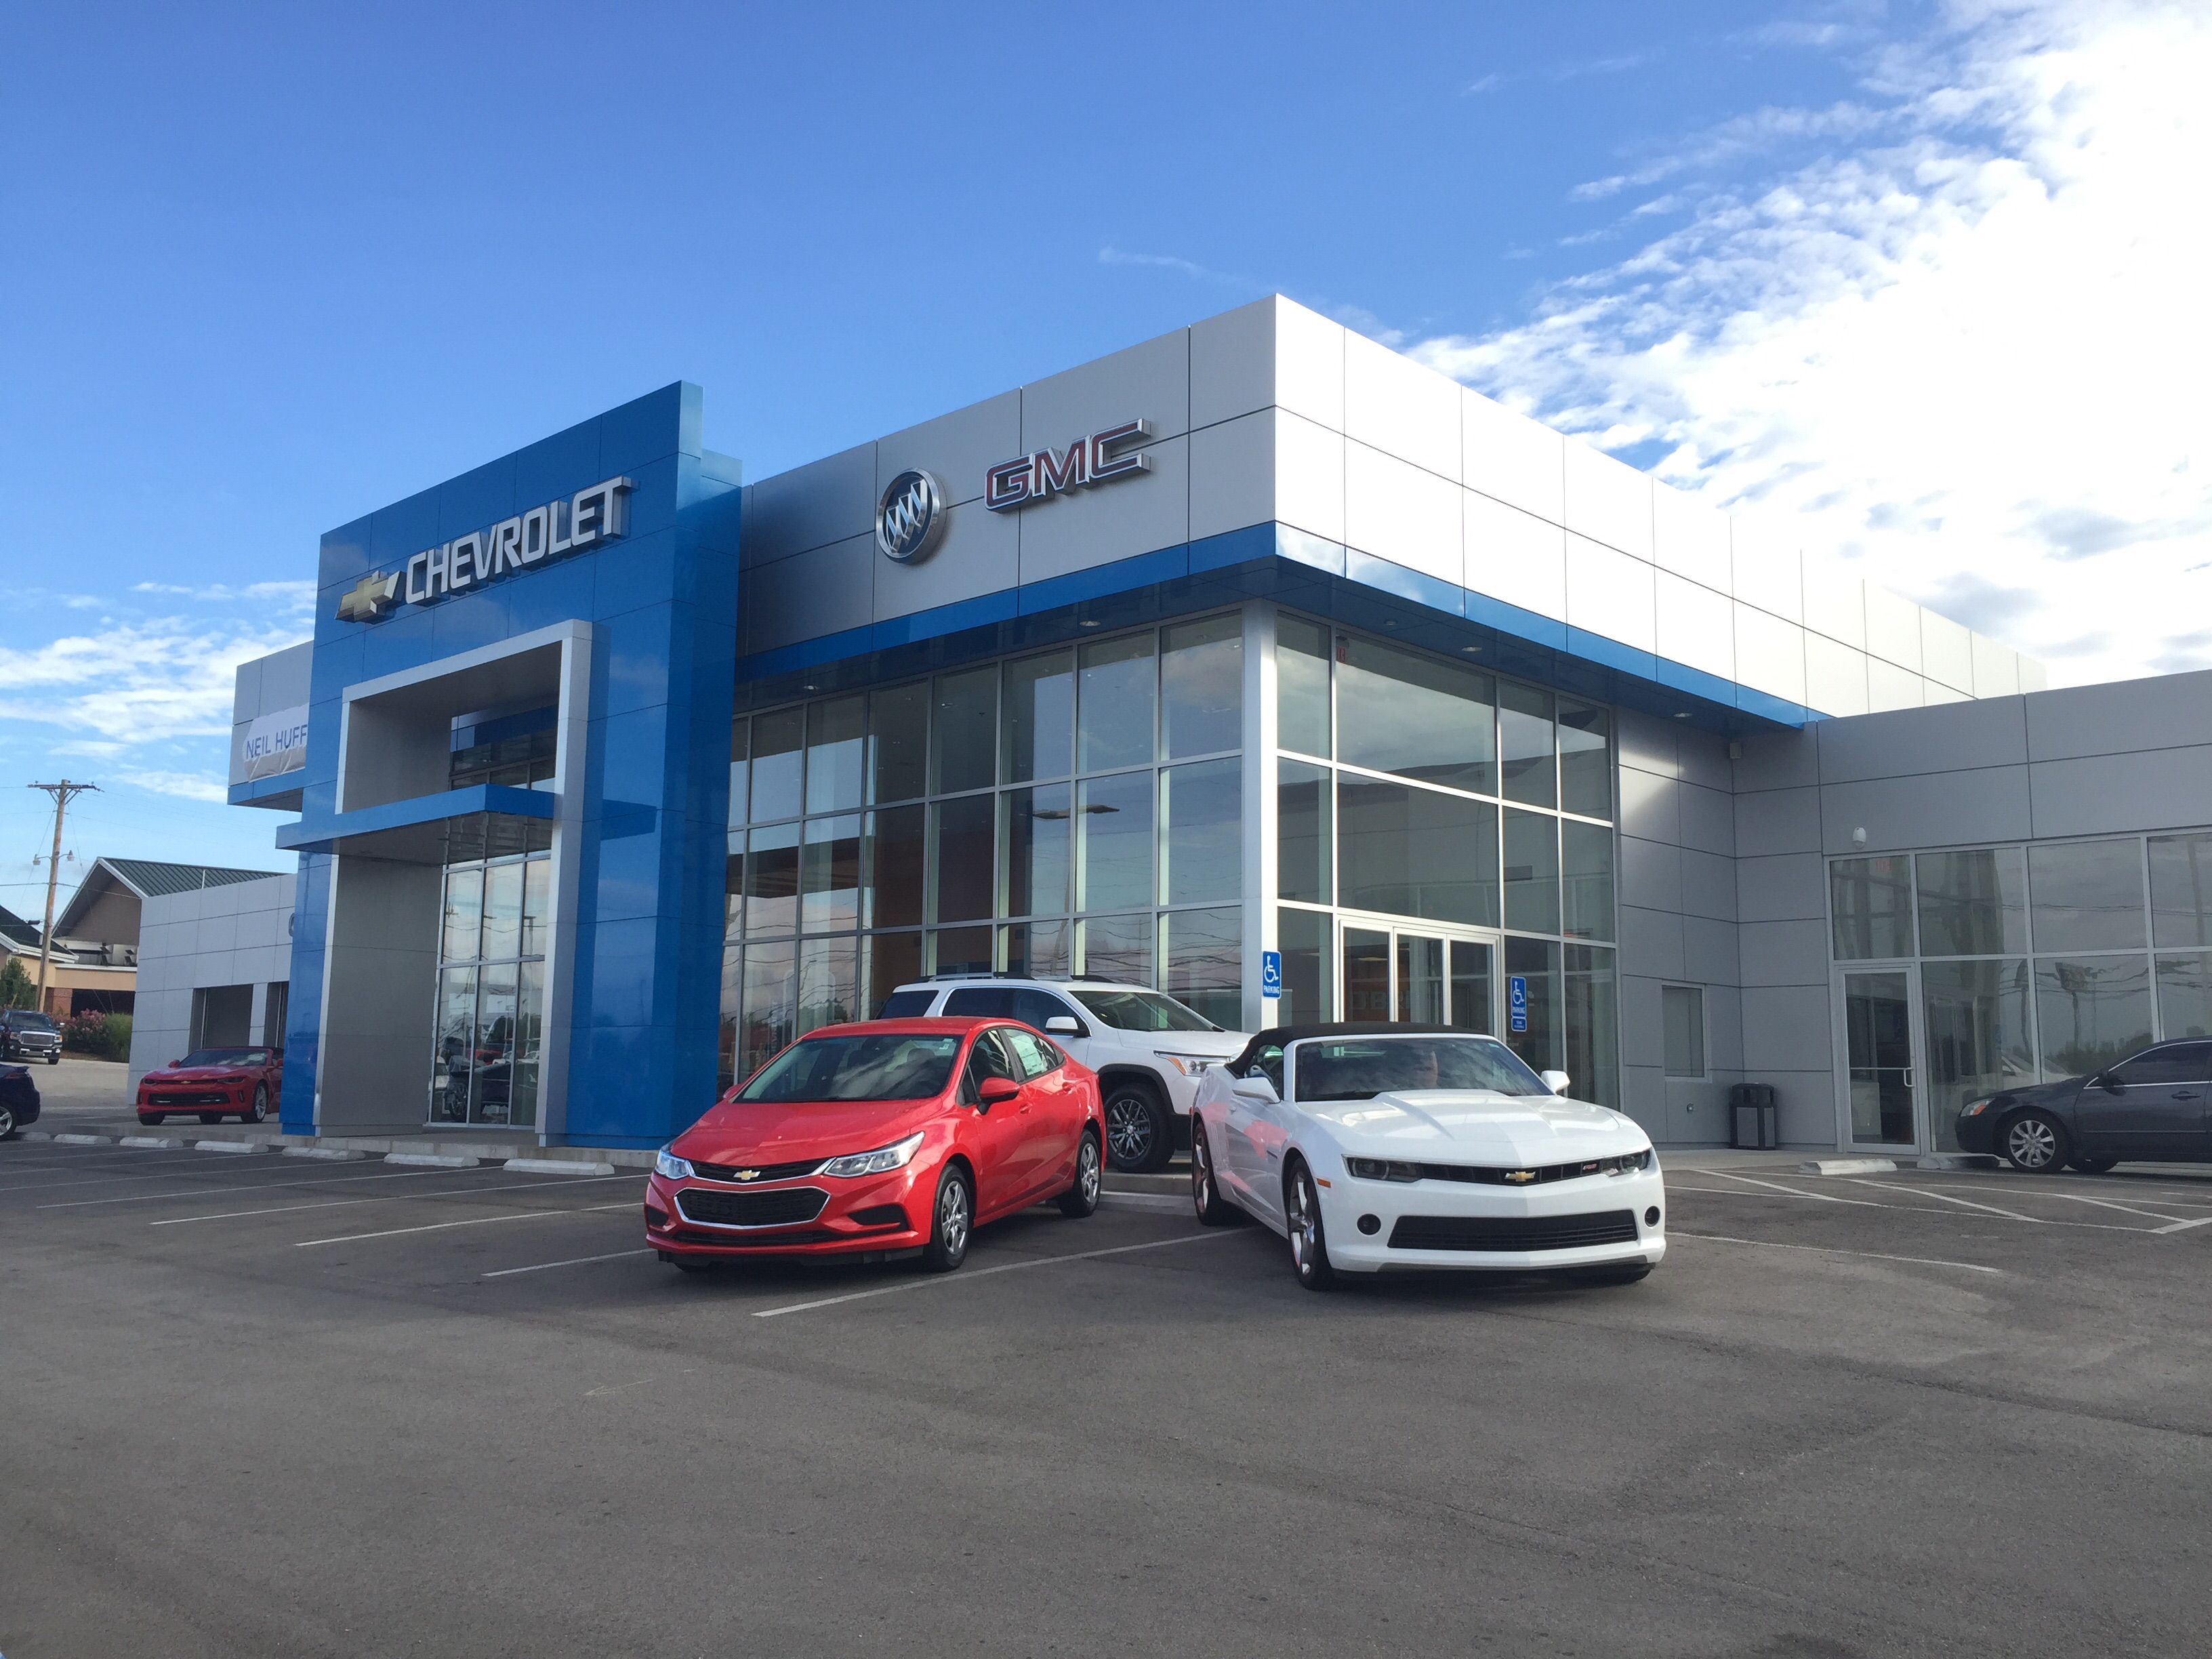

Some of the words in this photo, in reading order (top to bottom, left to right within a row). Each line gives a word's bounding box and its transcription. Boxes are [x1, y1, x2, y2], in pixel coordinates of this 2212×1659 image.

[985, 418, 1149, 512] GMC
[407, 476, 632, 605] CHEVROLET
[246, 735, 271, 759] NEIL
[275, 724, 308, 751] HUFF
[1263, 985, 1280, 994] PARKING
